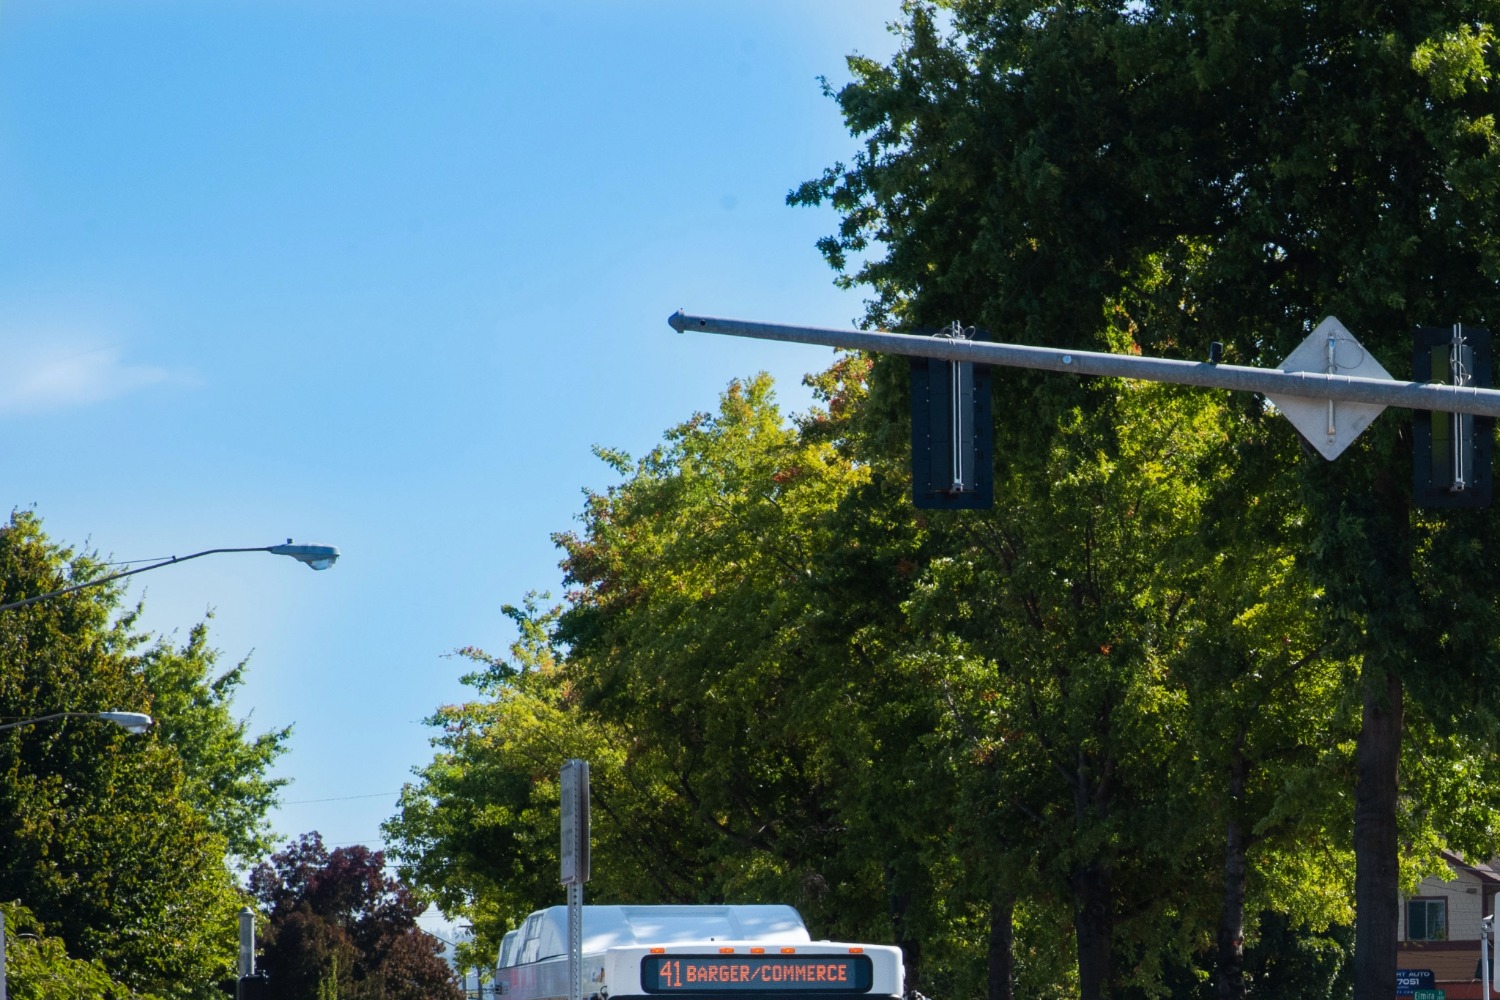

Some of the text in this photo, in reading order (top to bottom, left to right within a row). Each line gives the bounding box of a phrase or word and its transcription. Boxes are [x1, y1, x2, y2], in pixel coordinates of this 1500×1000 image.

[659, 960, 847, 987] 41 BARGER/COMMERCE
[1414, 991, 1435, 1000] Elmira
